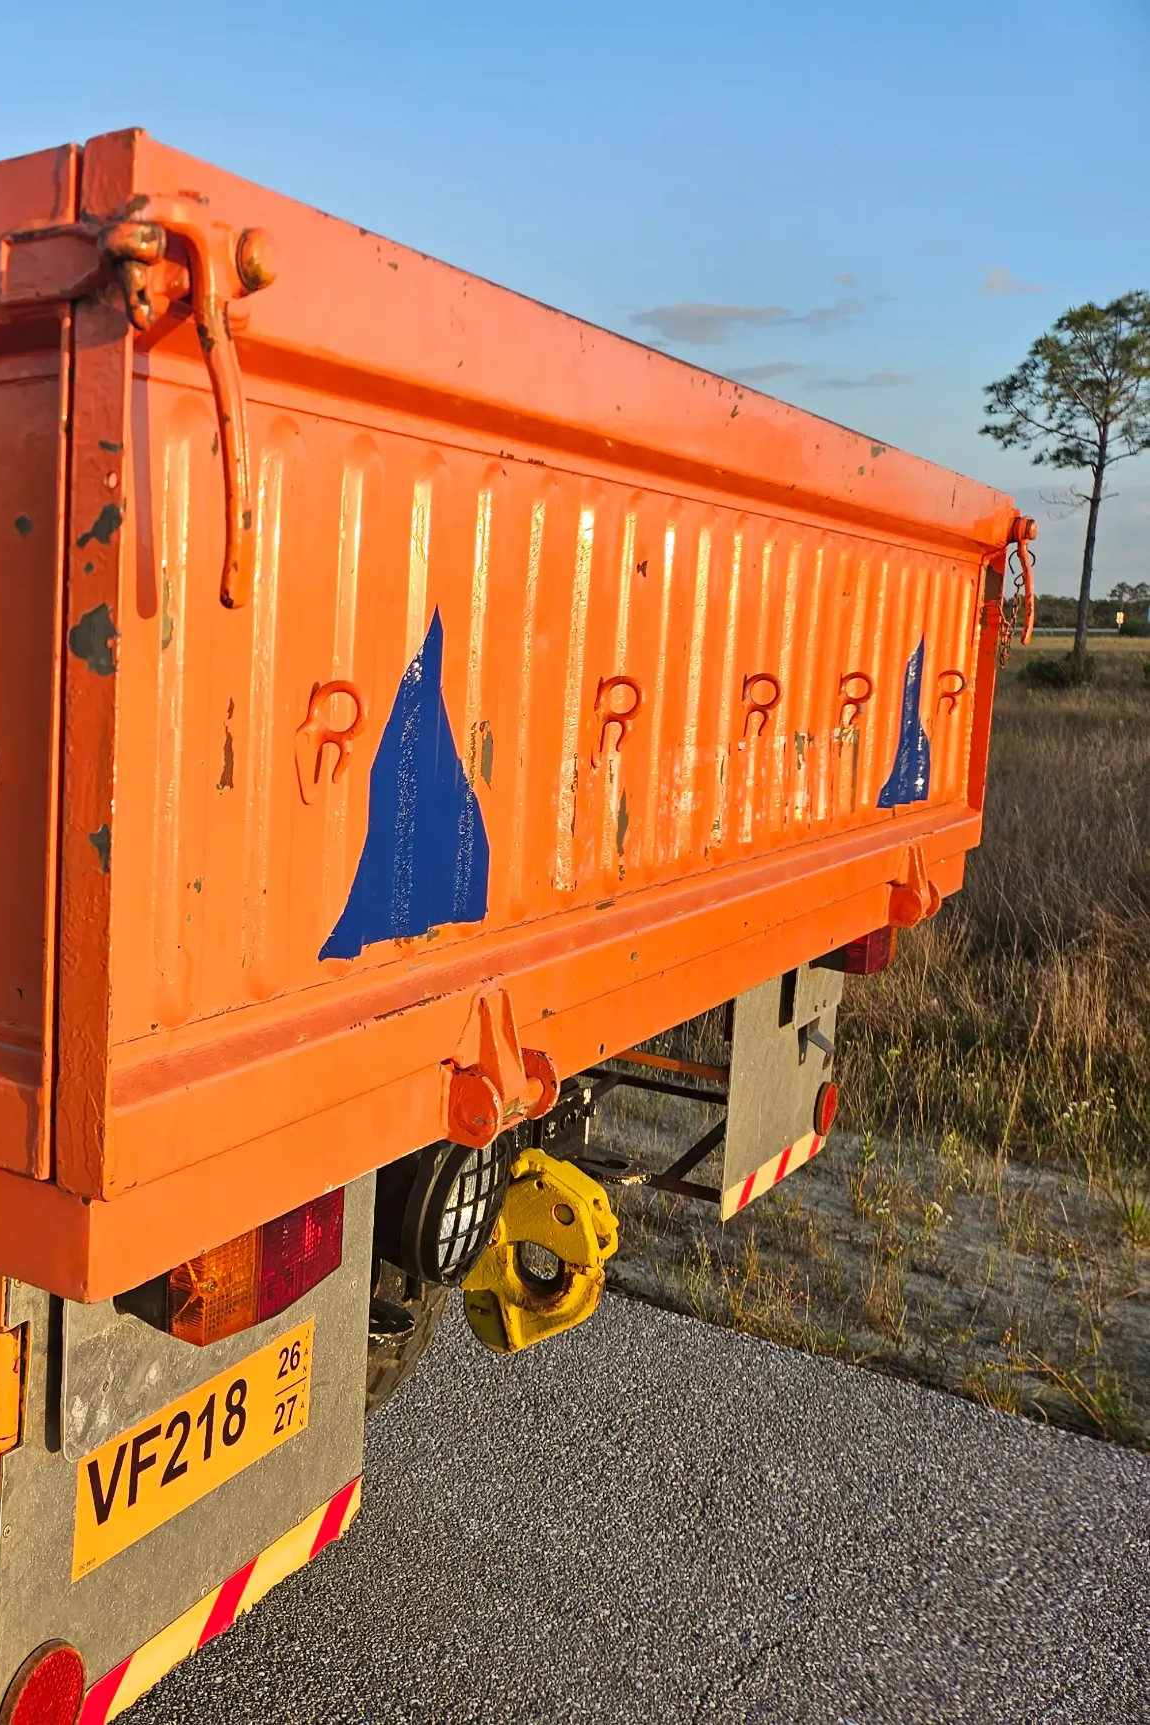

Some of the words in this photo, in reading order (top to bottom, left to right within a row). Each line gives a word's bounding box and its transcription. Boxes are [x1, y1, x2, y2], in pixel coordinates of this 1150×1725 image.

[277, 1341, 301, 1380] 26
[273, 1394, 298, 1435] 27
[87, 1379, 248, 1526] VF218
